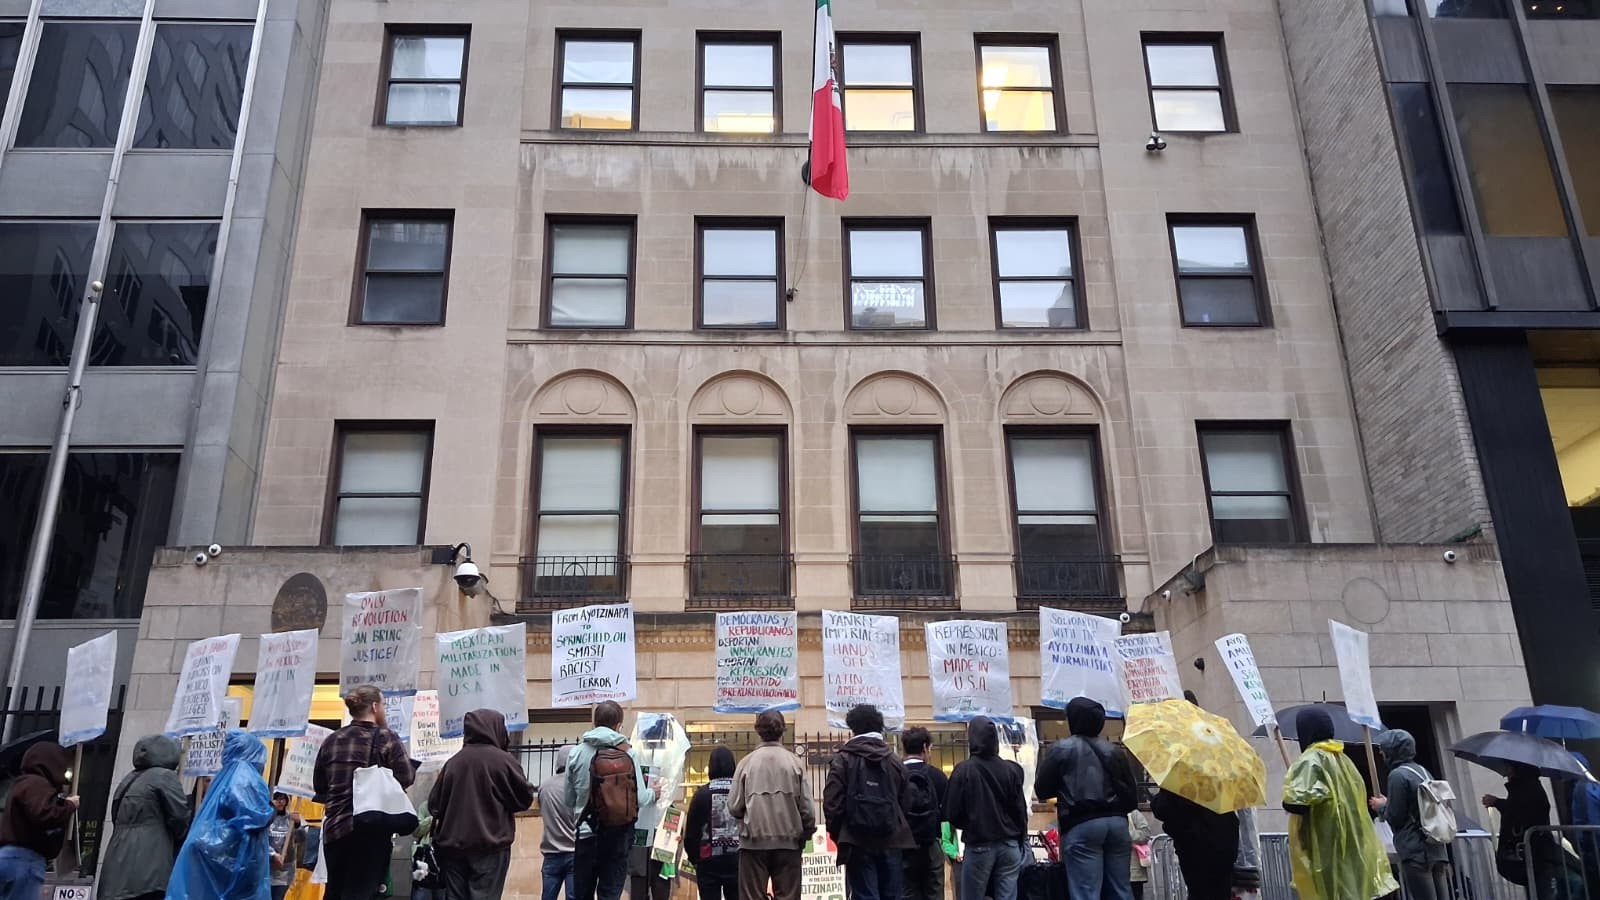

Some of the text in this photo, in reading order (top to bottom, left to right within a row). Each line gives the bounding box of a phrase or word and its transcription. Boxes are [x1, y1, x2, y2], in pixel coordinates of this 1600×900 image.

[361, 595, 386, 610] ONLY
[352, 609, 408, 627] REVOLUTION
[557, 607, 629, 624] FROM AYOTZINAPA
[729, 626, 793, 636] REPUBLICANOS
[935, 625, 998, 641] REPRESSION
[1053, 628, 1076, 639] WITH
[450, 633, 504, 650] MEXICAN
[353, 645, 399, 662] JUSTICE!
[567, 644, 605, 659] SMASH
[730, 646, 793, 658] INMIGRANTES
[833, 643, 878, 659] HANDS
[946, 644, 956, 655] IN
[1048, 641, 1108, 658] AYOTZINAPA
[842, 656, 865, 667] OFF
[943, 659, 989, 673] MADE IN
[1052, 655, 1113, 672] NORMALISTAS
[451, 663, 500, 679] MADE IN
[560, 661, 601, 678] RACIST
[730, 663, 788, 676] REPRESIÓN
[742, 676, 782, 686] PARTIDO
[828, 673, 863, 685] LATIN
[837, 686, 883, 697] AMERICA
[803, 865, 842, 877] RRUPTION
[59, 889, 75, 899] NO
